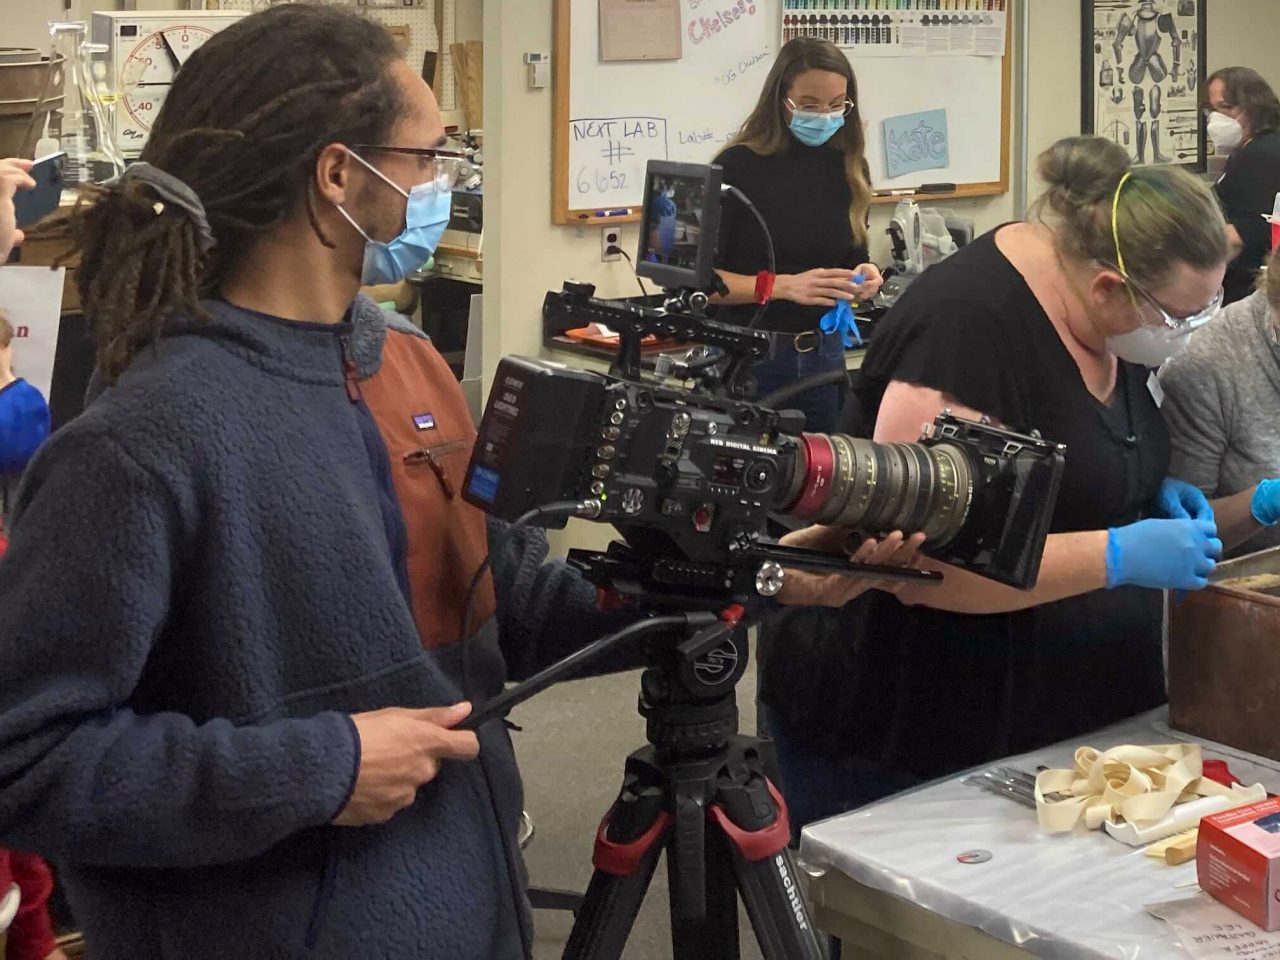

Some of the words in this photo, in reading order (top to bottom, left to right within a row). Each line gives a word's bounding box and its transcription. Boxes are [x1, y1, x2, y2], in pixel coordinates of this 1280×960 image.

[138, 102, 152, 110] 40
[574, 121, 617, 140] NEXT
[624, 121, 658, 139] LAB
[888, 120, 946, 170] Kate
[577, 166, 628, 194] 6652
[726, 441, 750, 451] DIGITAL
[752, 445, 777, 455] CINEMA
[775, 855, 808, 930] sachtler
